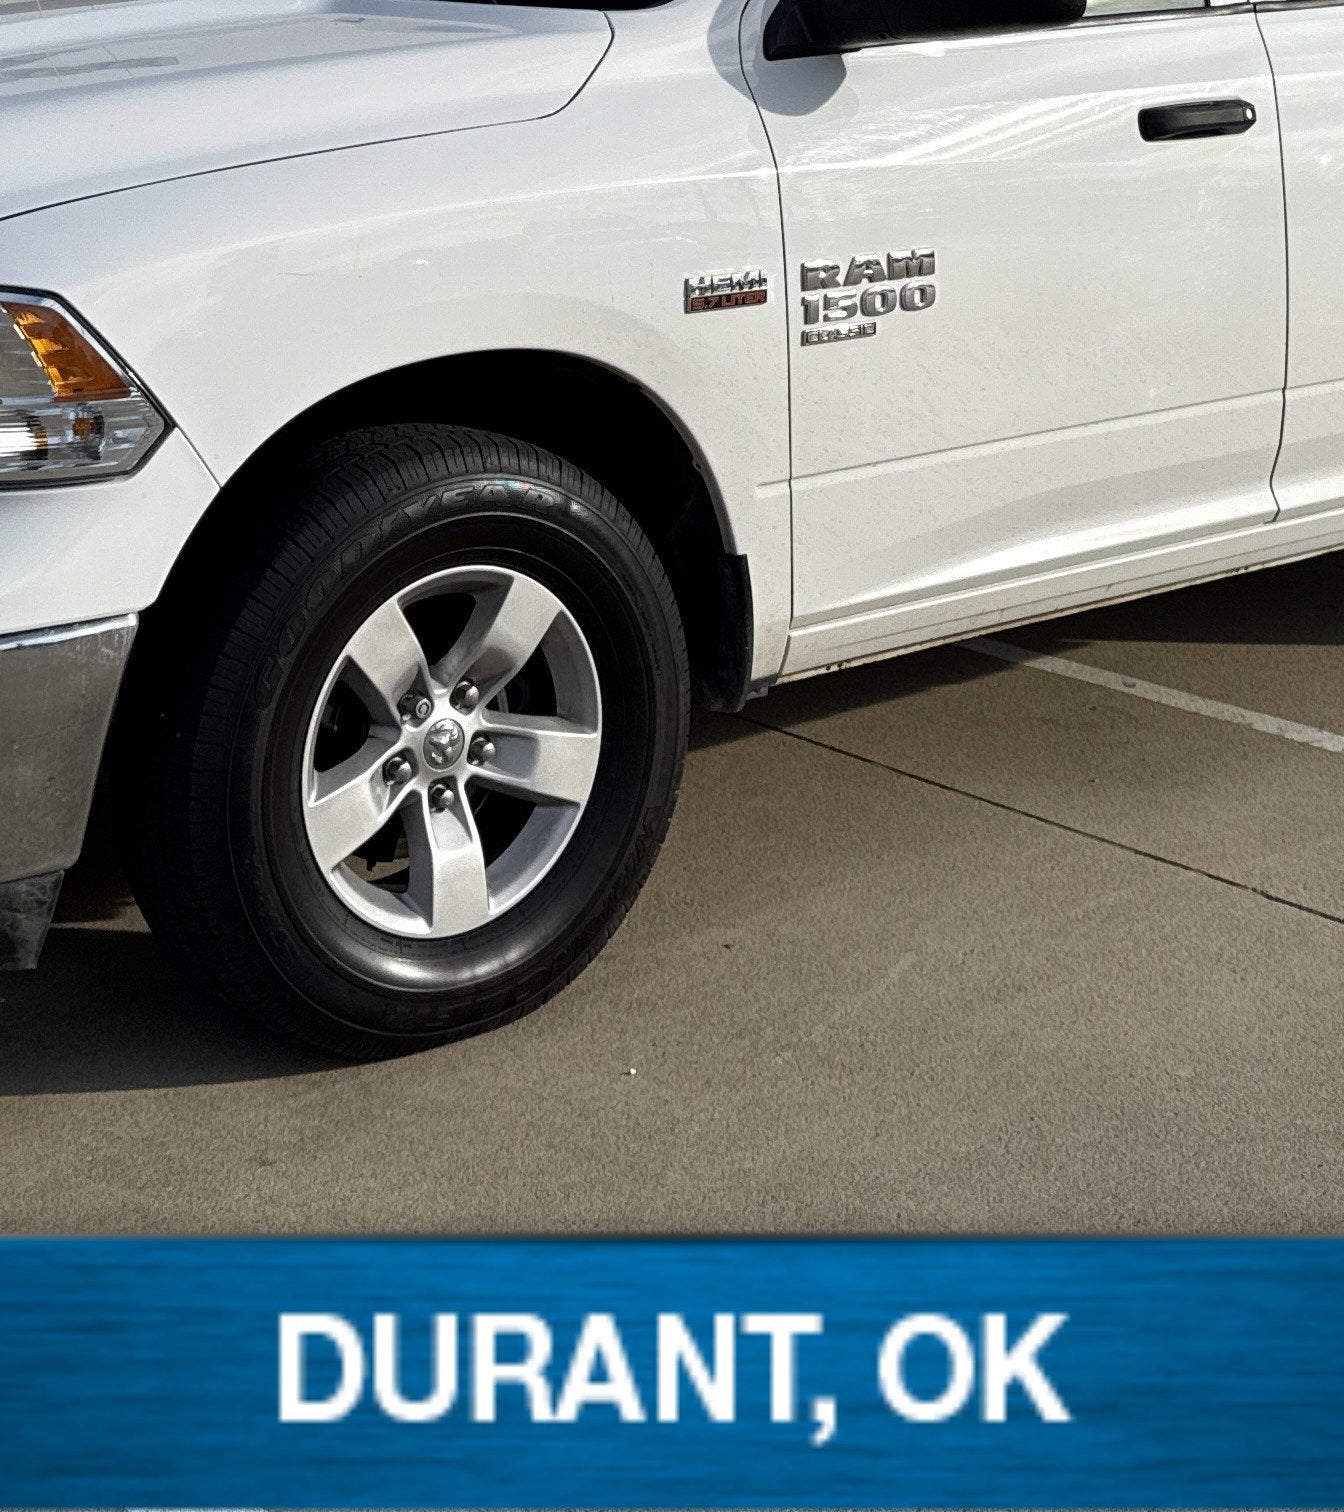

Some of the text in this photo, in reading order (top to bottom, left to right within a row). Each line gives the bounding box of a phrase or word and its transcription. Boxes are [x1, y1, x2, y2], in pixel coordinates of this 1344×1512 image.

[684, 268, 768, 297] HEMI
[800, 248, 936, 292] RAM
[800, 281, 937, 325] 1500
